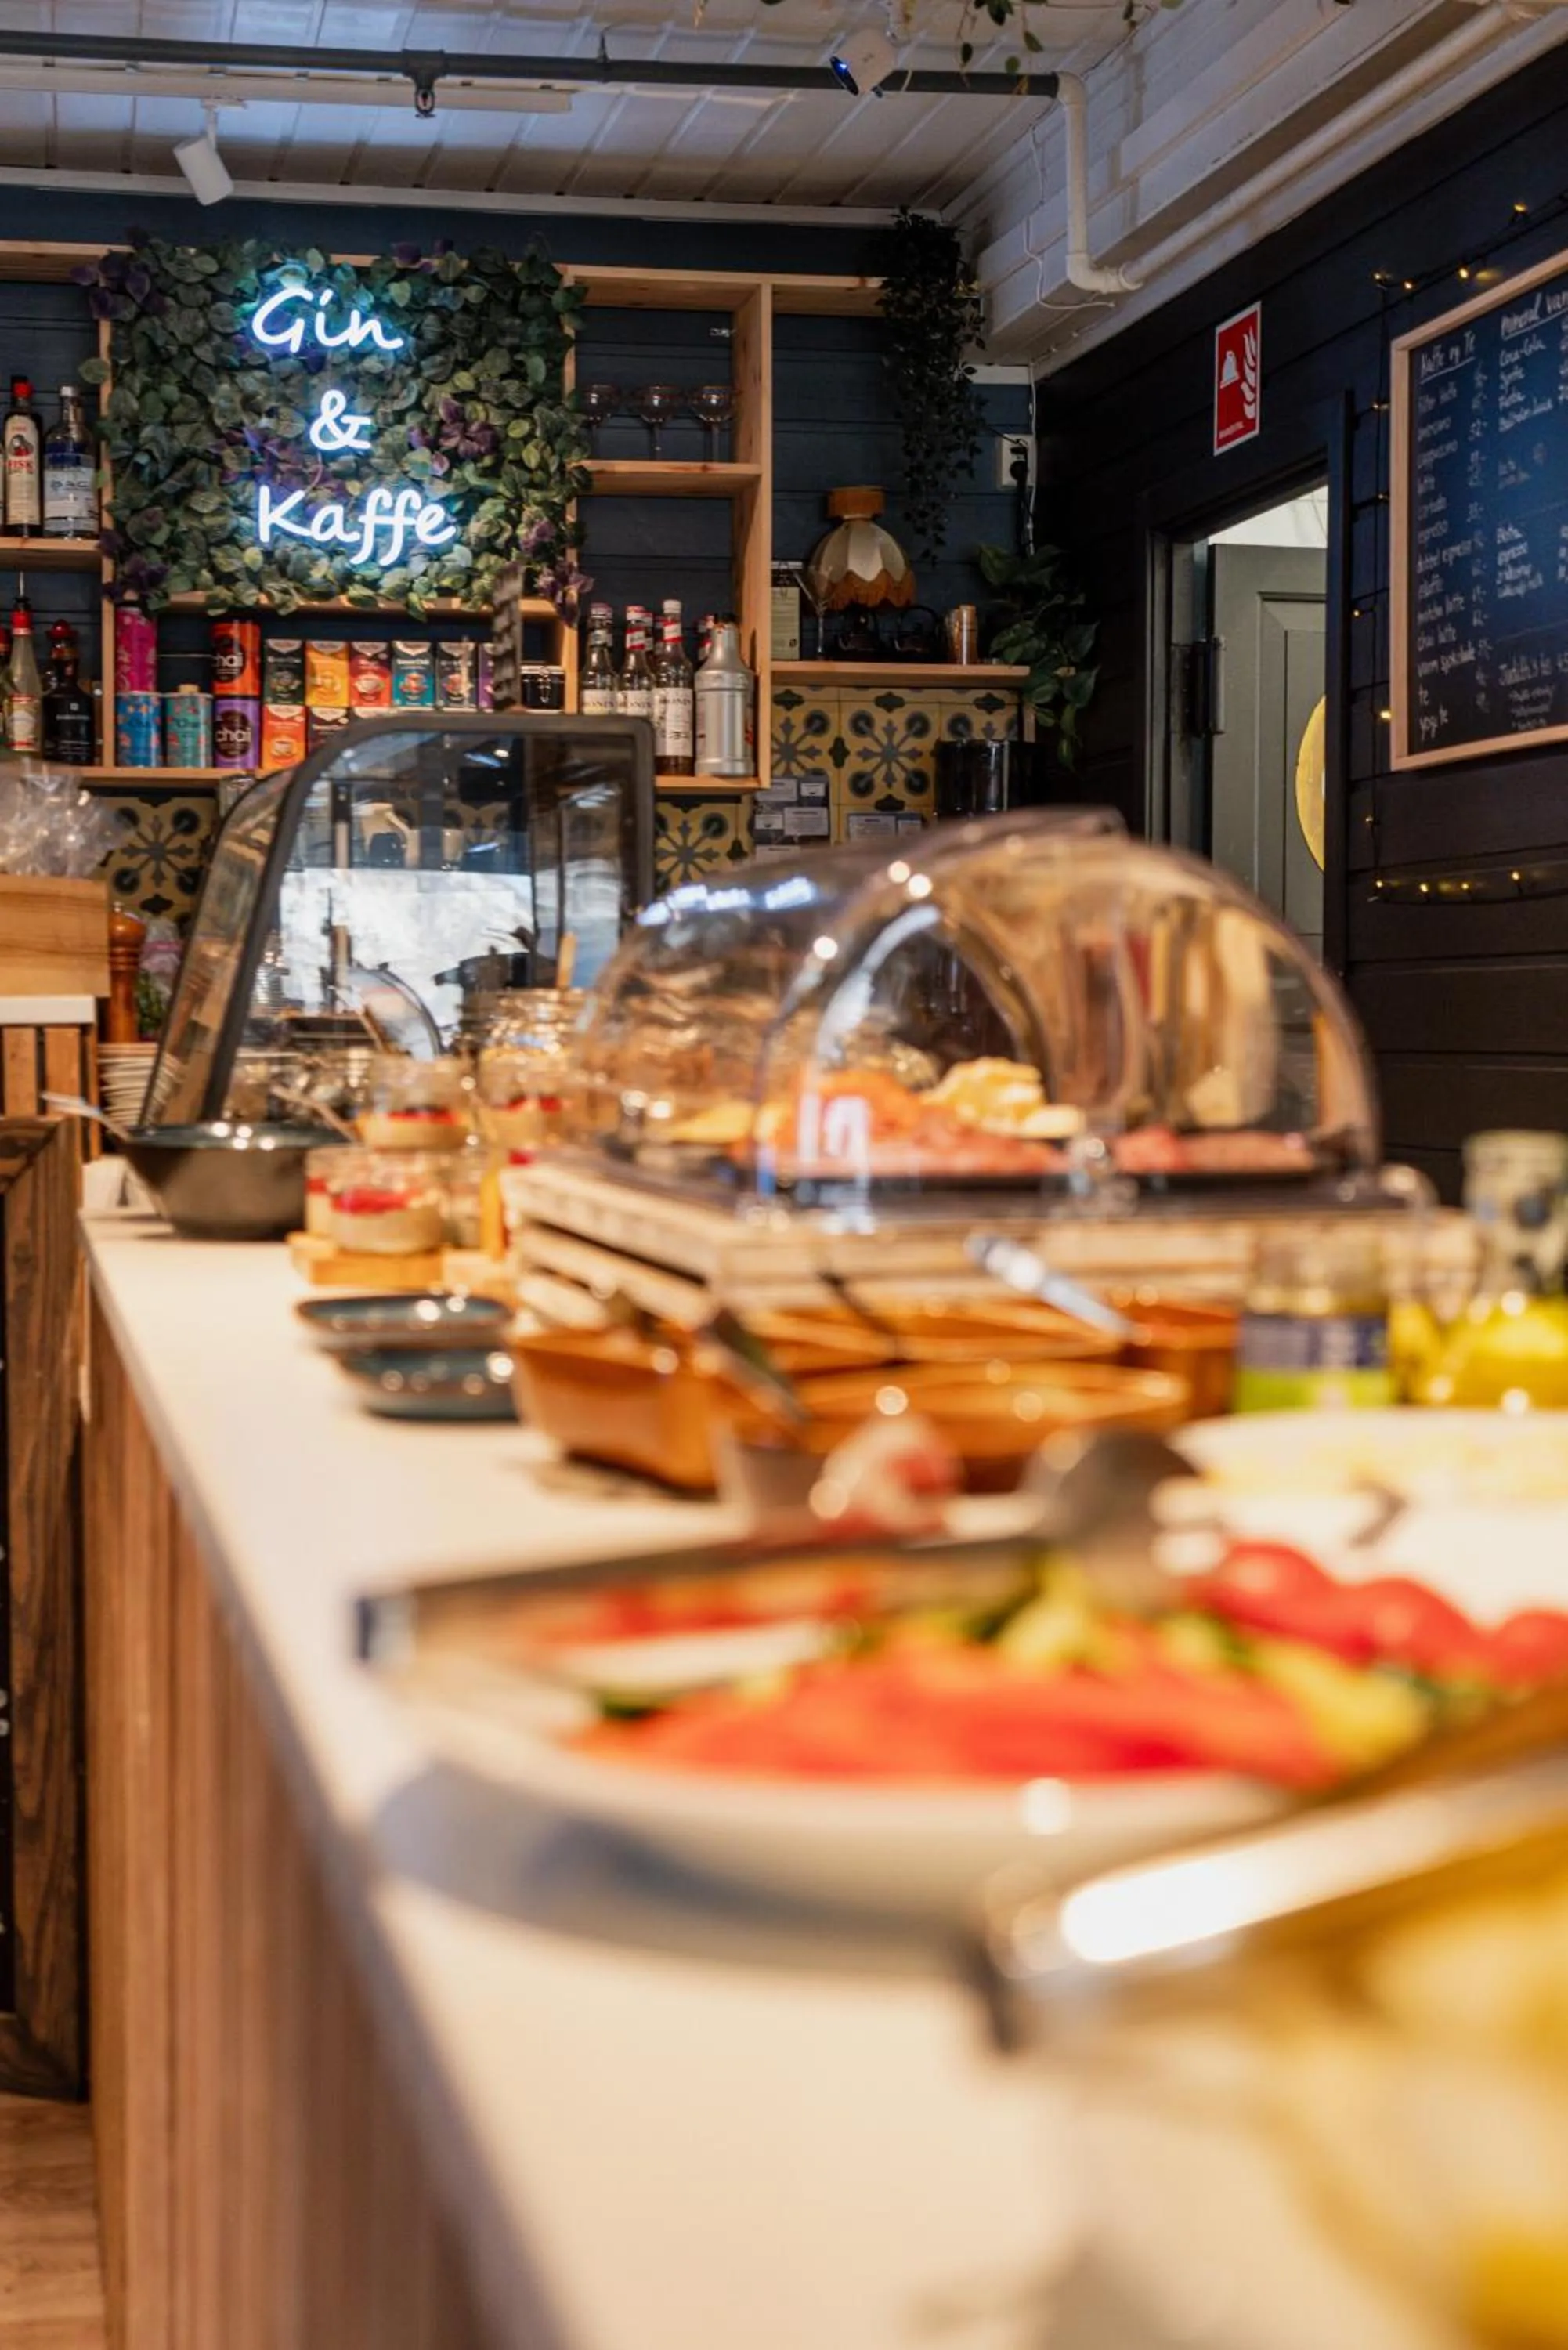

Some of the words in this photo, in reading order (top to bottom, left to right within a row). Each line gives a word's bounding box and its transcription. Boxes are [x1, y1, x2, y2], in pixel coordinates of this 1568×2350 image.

[251, 287, 404, 352] Gin
[309, 389, 371, 451] &
[259, 486, 456, 566] Kaffe
[215, 728, 251, 743] chai
